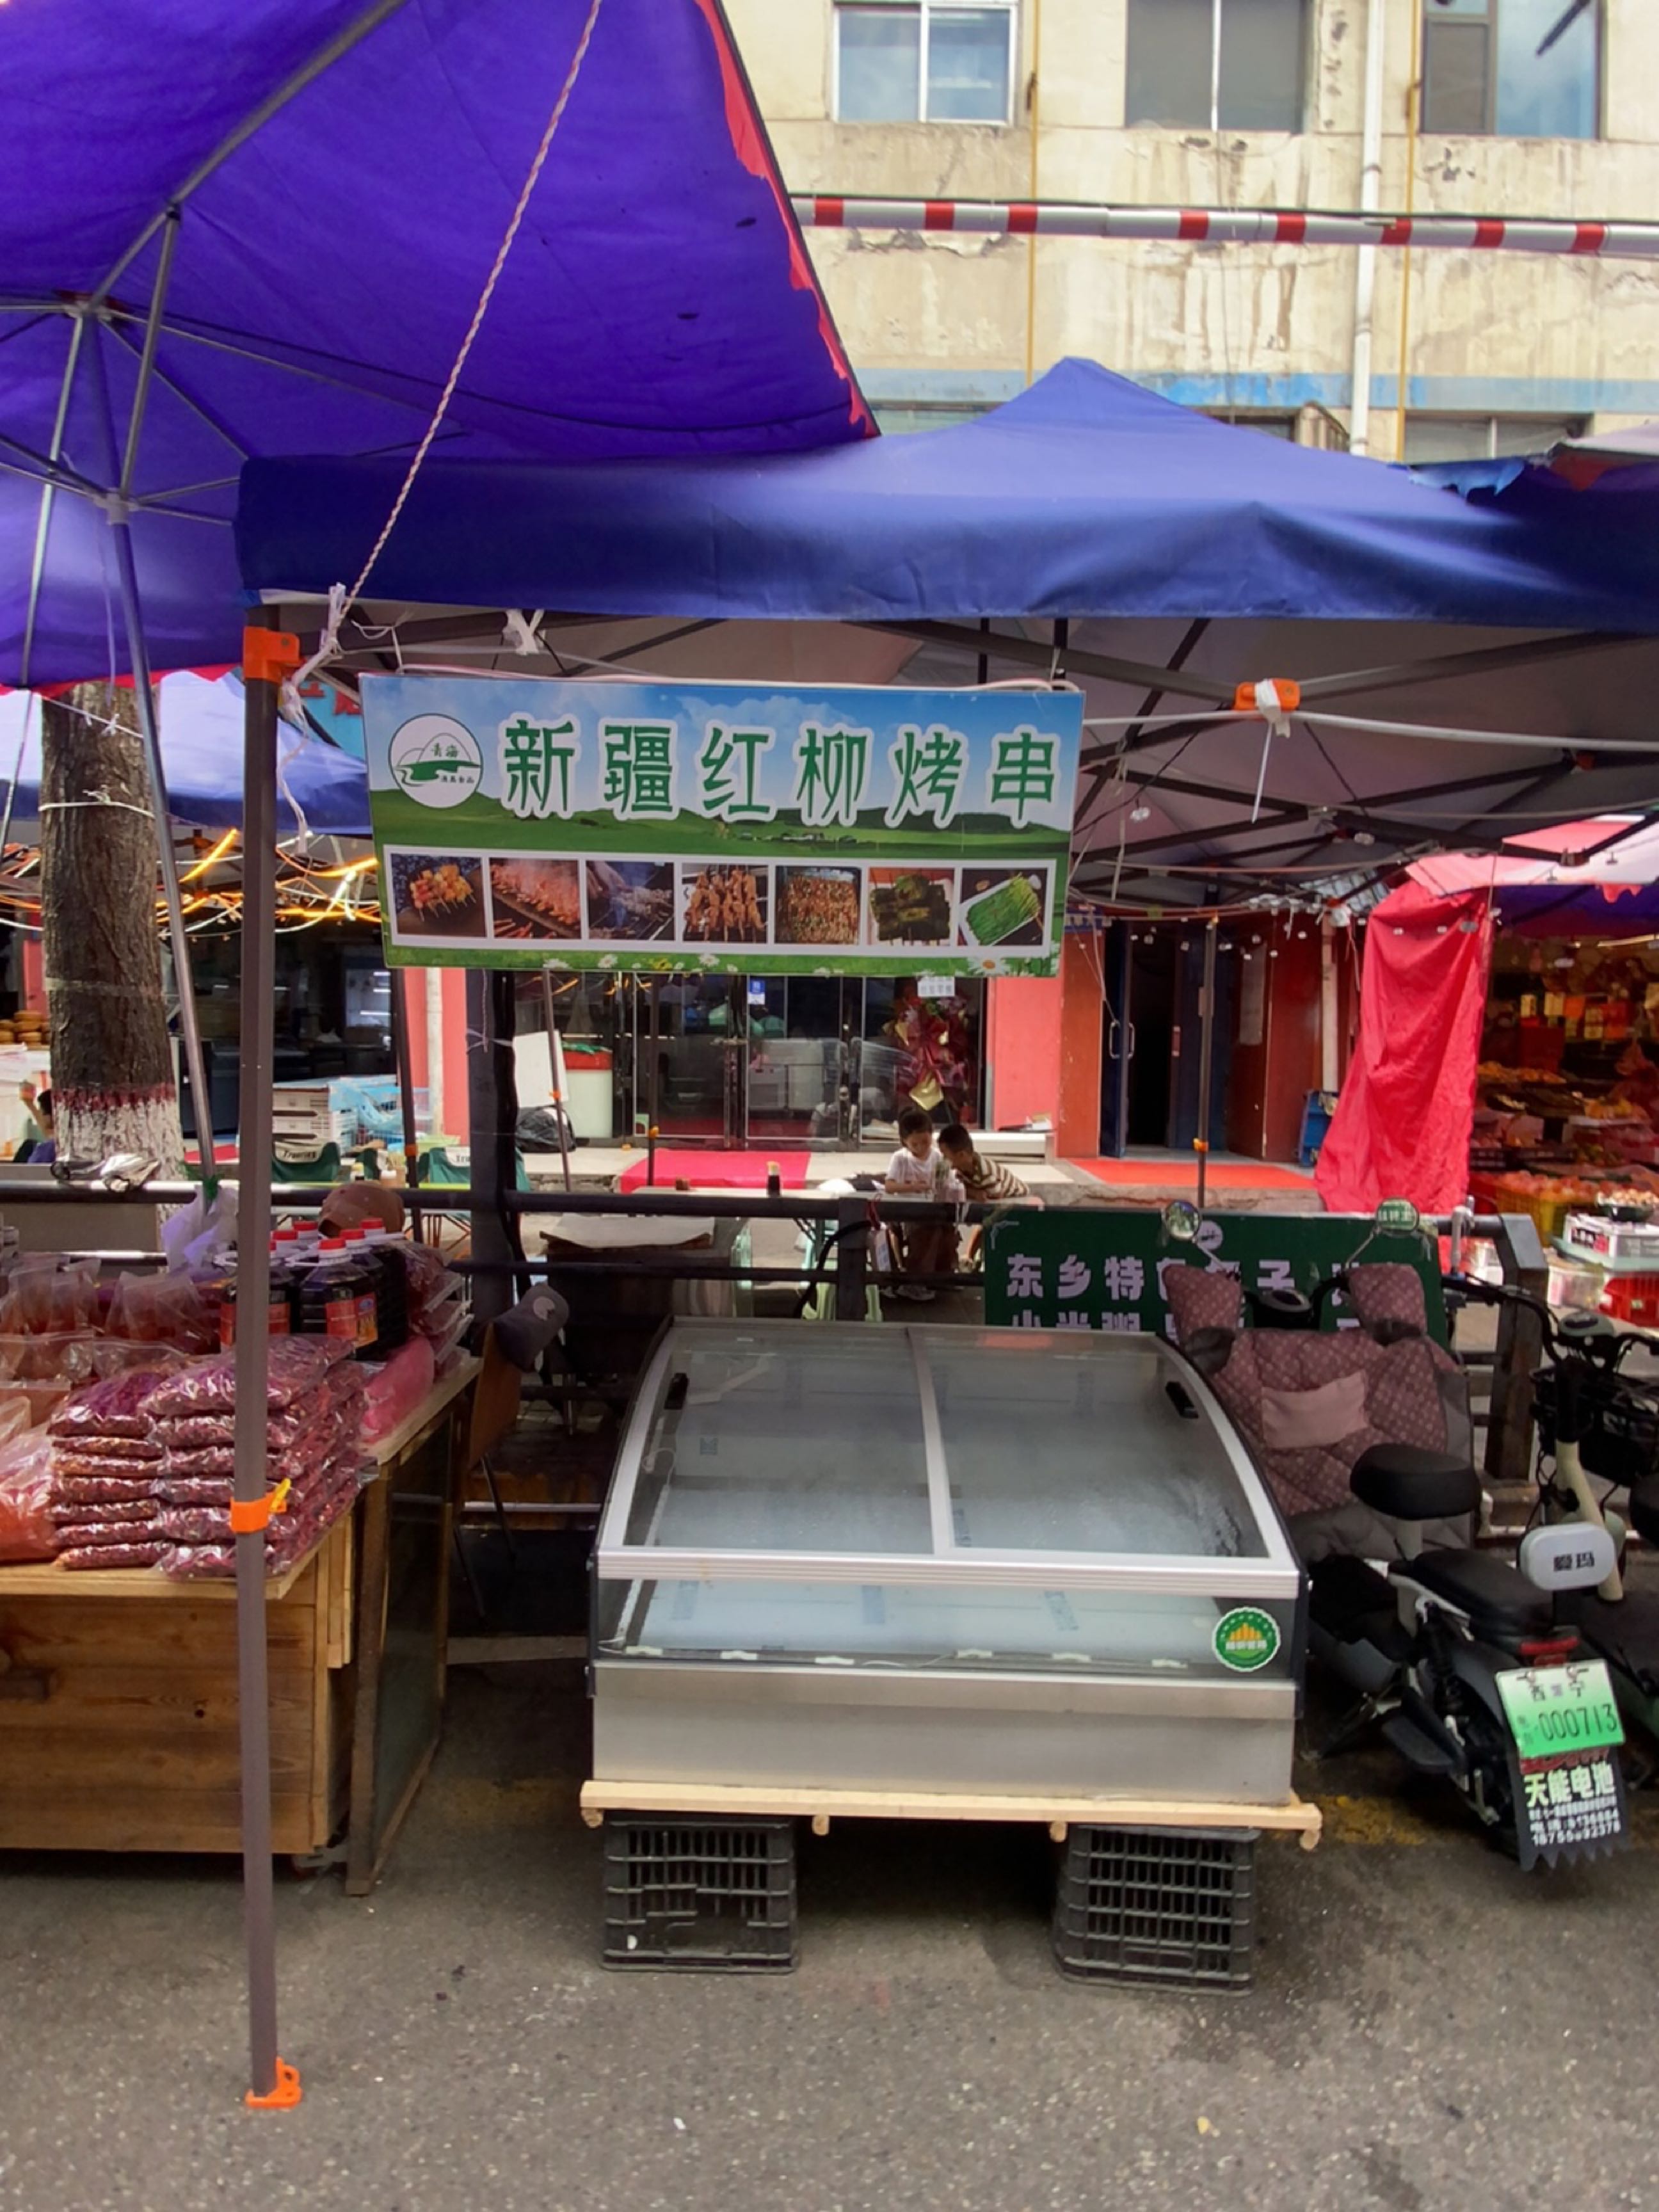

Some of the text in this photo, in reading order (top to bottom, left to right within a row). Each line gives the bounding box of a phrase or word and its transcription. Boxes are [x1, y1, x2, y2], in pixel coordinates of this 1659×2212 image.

[431, 742, 458, 758] 青海
[504, 719, 1055, 824] 新疆红柳烤串
[1539, 1704, 1617, 1741] 000713
[1523, 1761, 1615, 1807] 天能电池
